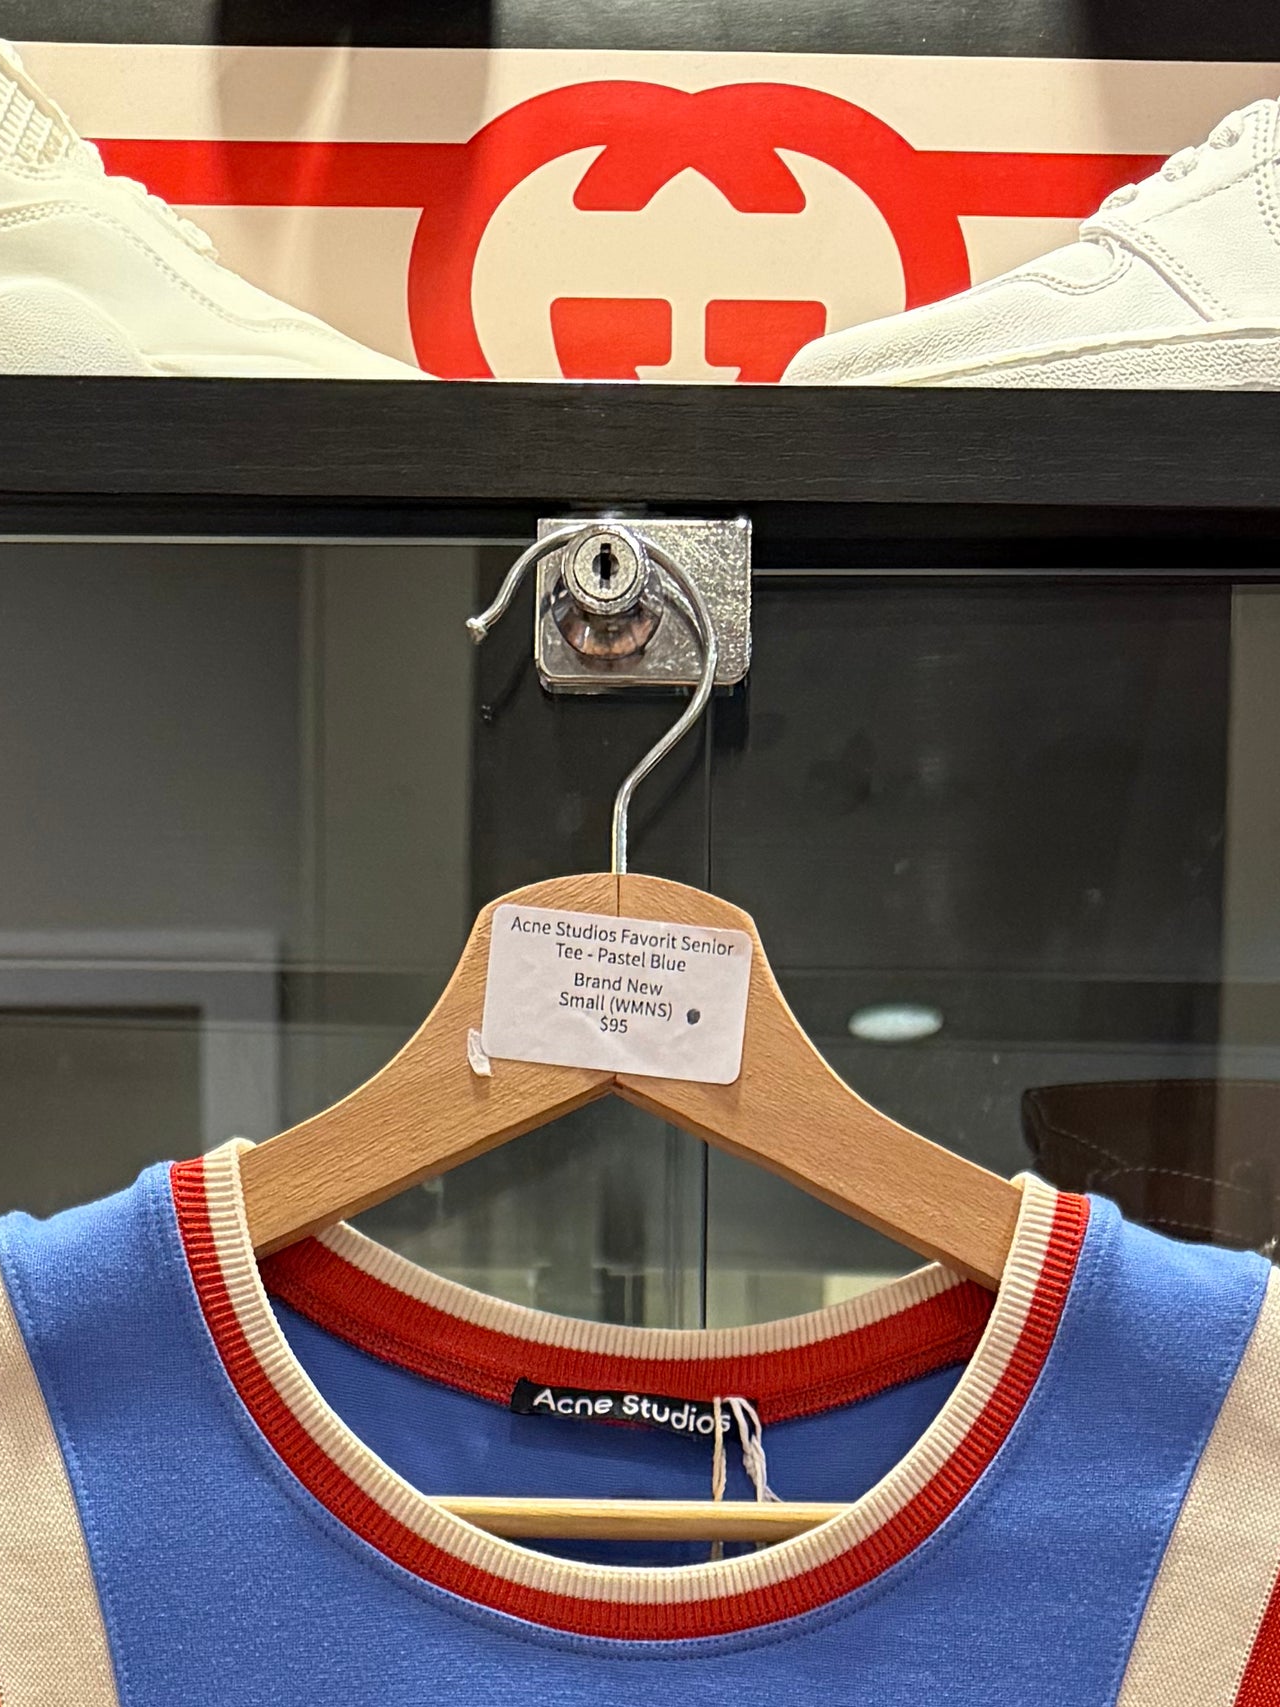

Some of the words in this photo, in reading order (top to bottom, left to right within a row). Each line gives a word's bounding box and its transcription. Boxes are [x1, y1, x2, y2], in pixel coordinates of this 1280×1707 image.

[510, 916, 551, 936] Acne
[555, 921, 617, 943] Studios
[620, 929, 677, 950] Favorit
[681, 935, 734, 956] Senior
[556, 943, 583, 961] Tee
[597, 948, 646, 968] Pastel
[650, 956, 687, 973] Blue
[574, 972, 621, 992] Brand
[627, 978, 664, 996] New
[558, 991, 605, 1011] Small
[609, 996, 674, 1021] (WMNS)
[599, 1015, 629, 1035] $95
[532, 1387, 614, 1417] Acne
[622, 1394, 732, 1434] Studios
